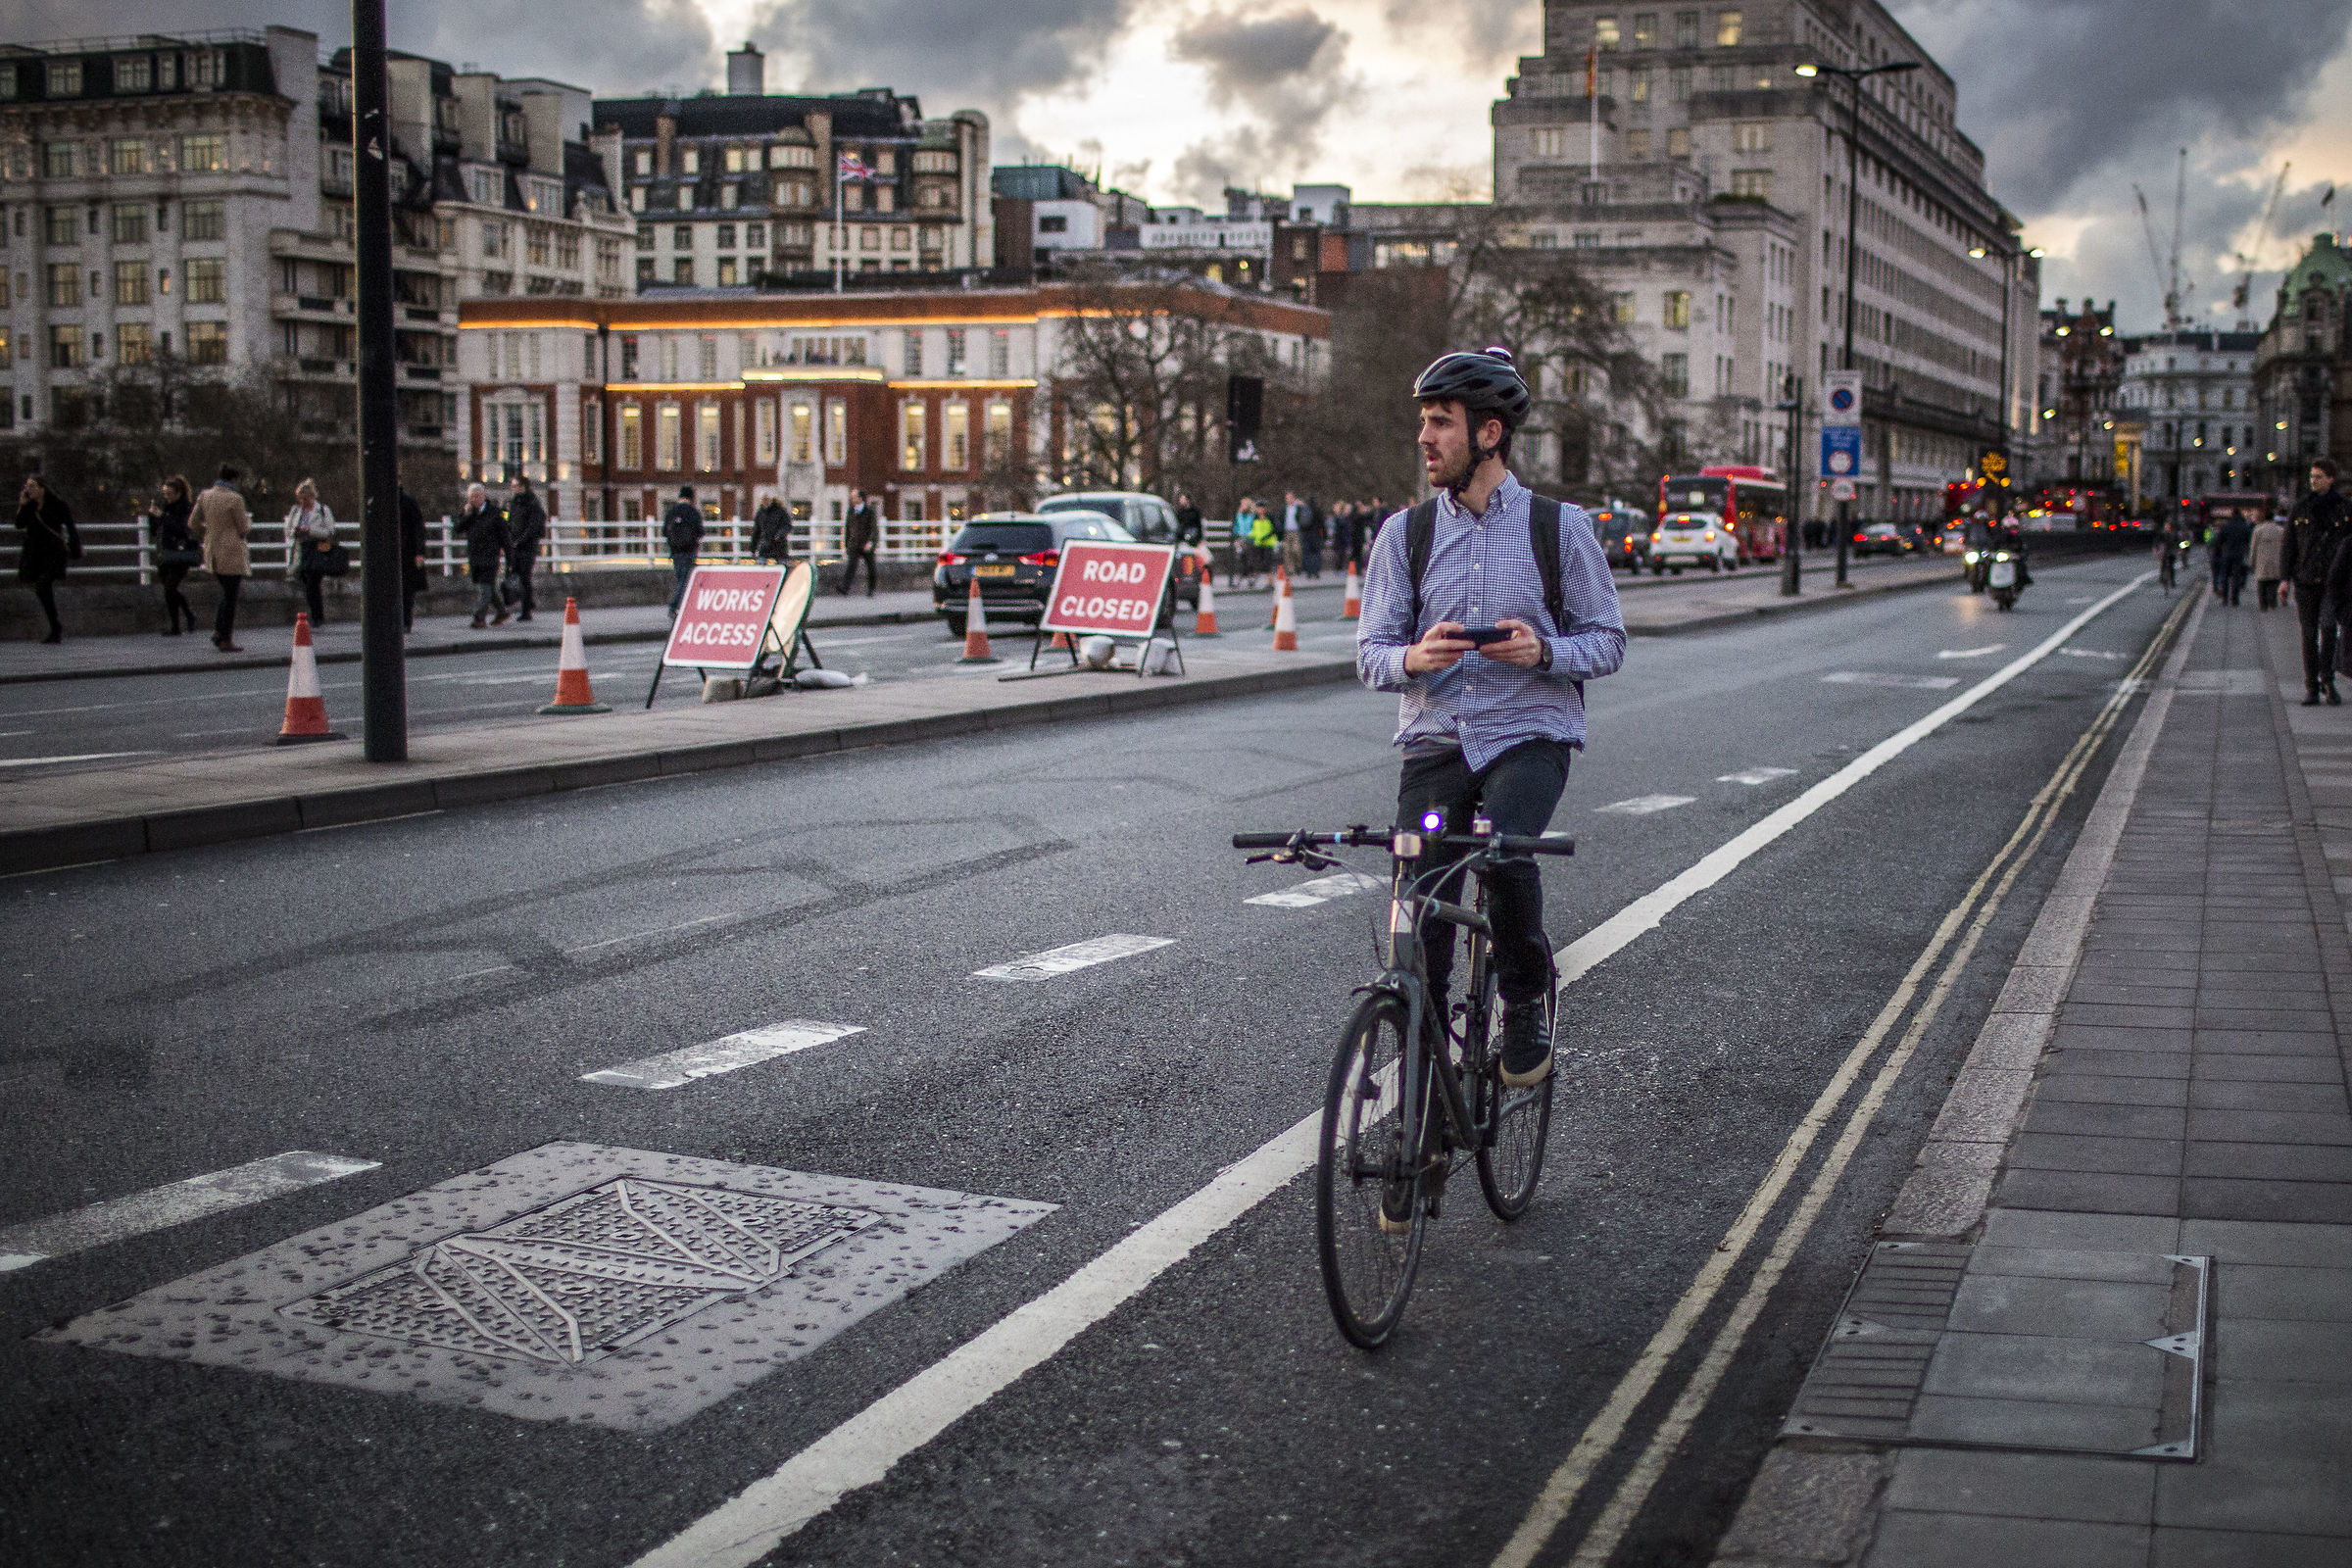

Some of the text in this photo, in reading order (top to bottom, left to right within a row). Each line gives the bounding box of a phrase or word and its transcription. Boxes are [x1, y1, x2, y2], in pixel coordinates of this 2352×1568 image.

[1083, 560, 1147, 584] ROAD
[697, 588, 765, 612] WORKS
[1059, 595, 1149, 620] CLOSED
[679, 621, 758, 646] ACCESS
